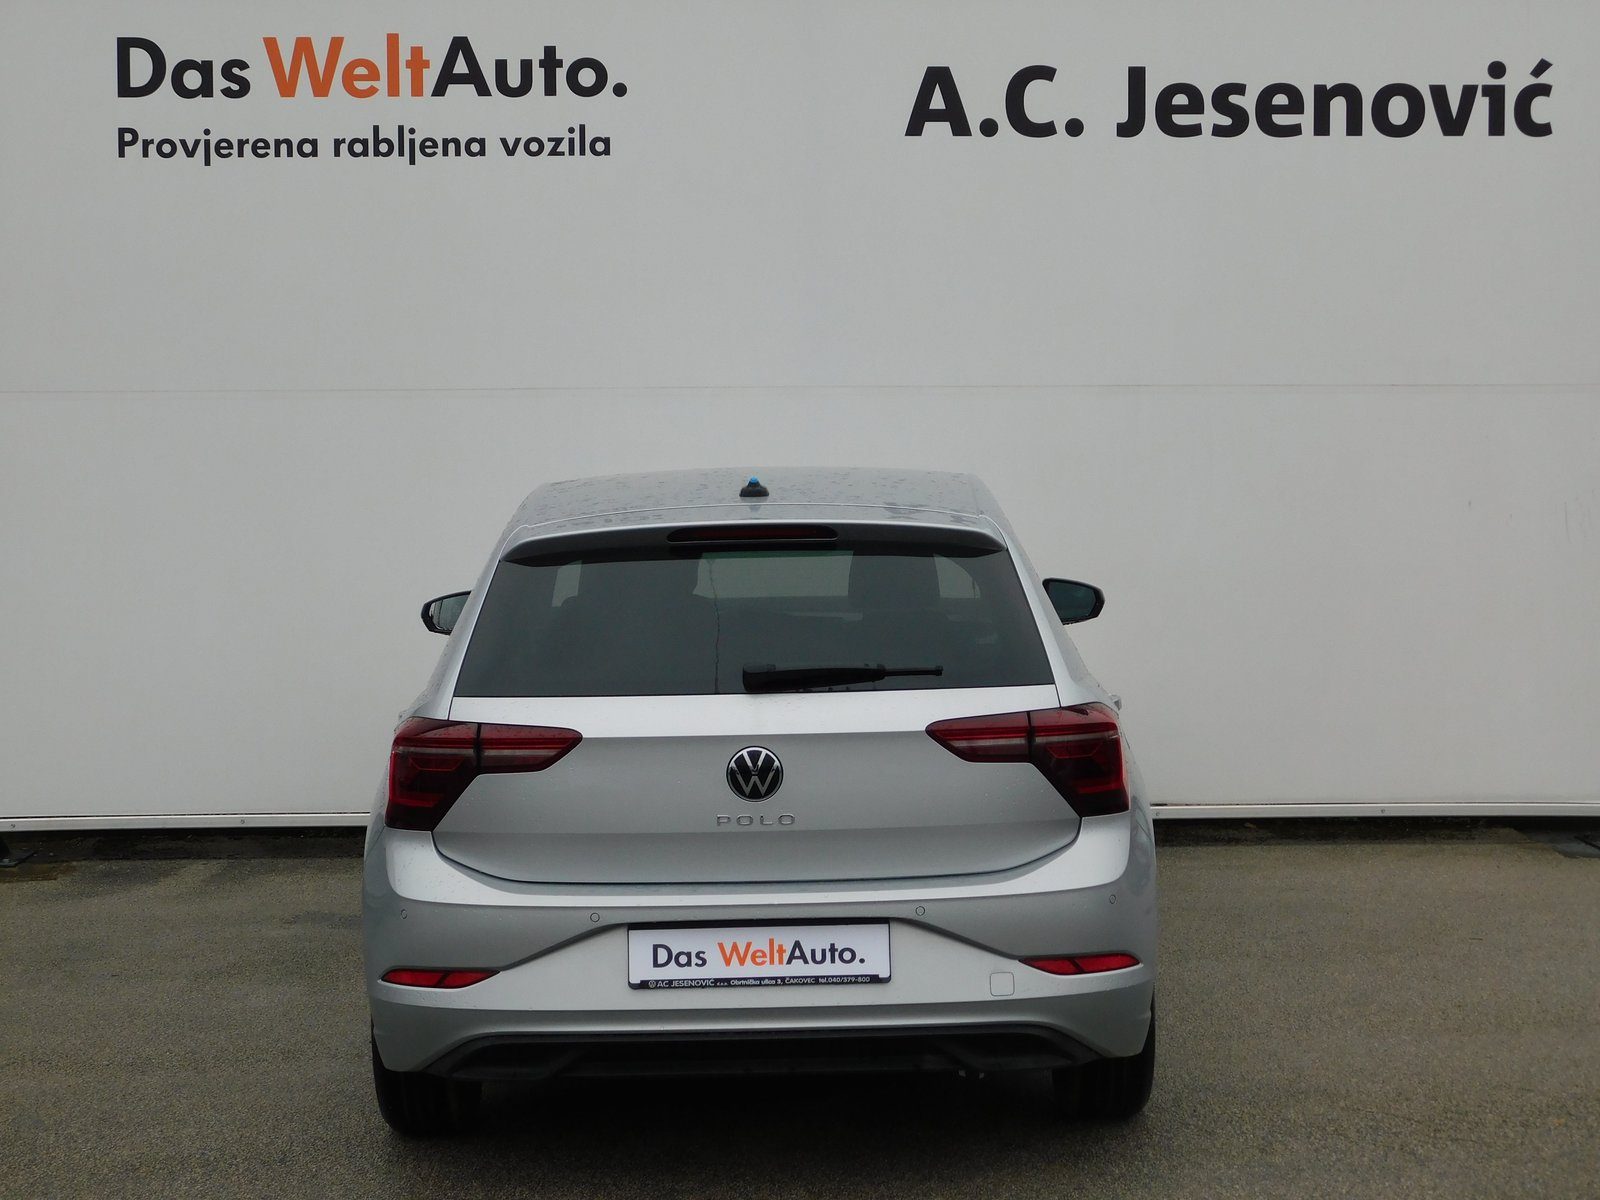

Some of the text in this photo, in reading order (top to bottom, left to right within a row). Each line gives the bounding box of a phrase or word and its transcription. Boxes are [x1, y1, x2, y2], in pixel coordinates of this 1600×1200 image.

[117, 33, 627, 99] Das WeltAuto.
[905, 58, 1553, 138] A.C. Jesenović
[118, 124, 611, 166] Provjerena rabljena vozila
[716, 814, 795, 826] POLO
[652, 937, 866, 969] Das WeltAuto.
[657, 980, 669, 988] AC
[670, 978, 715, 988] JESENOVIĆ
